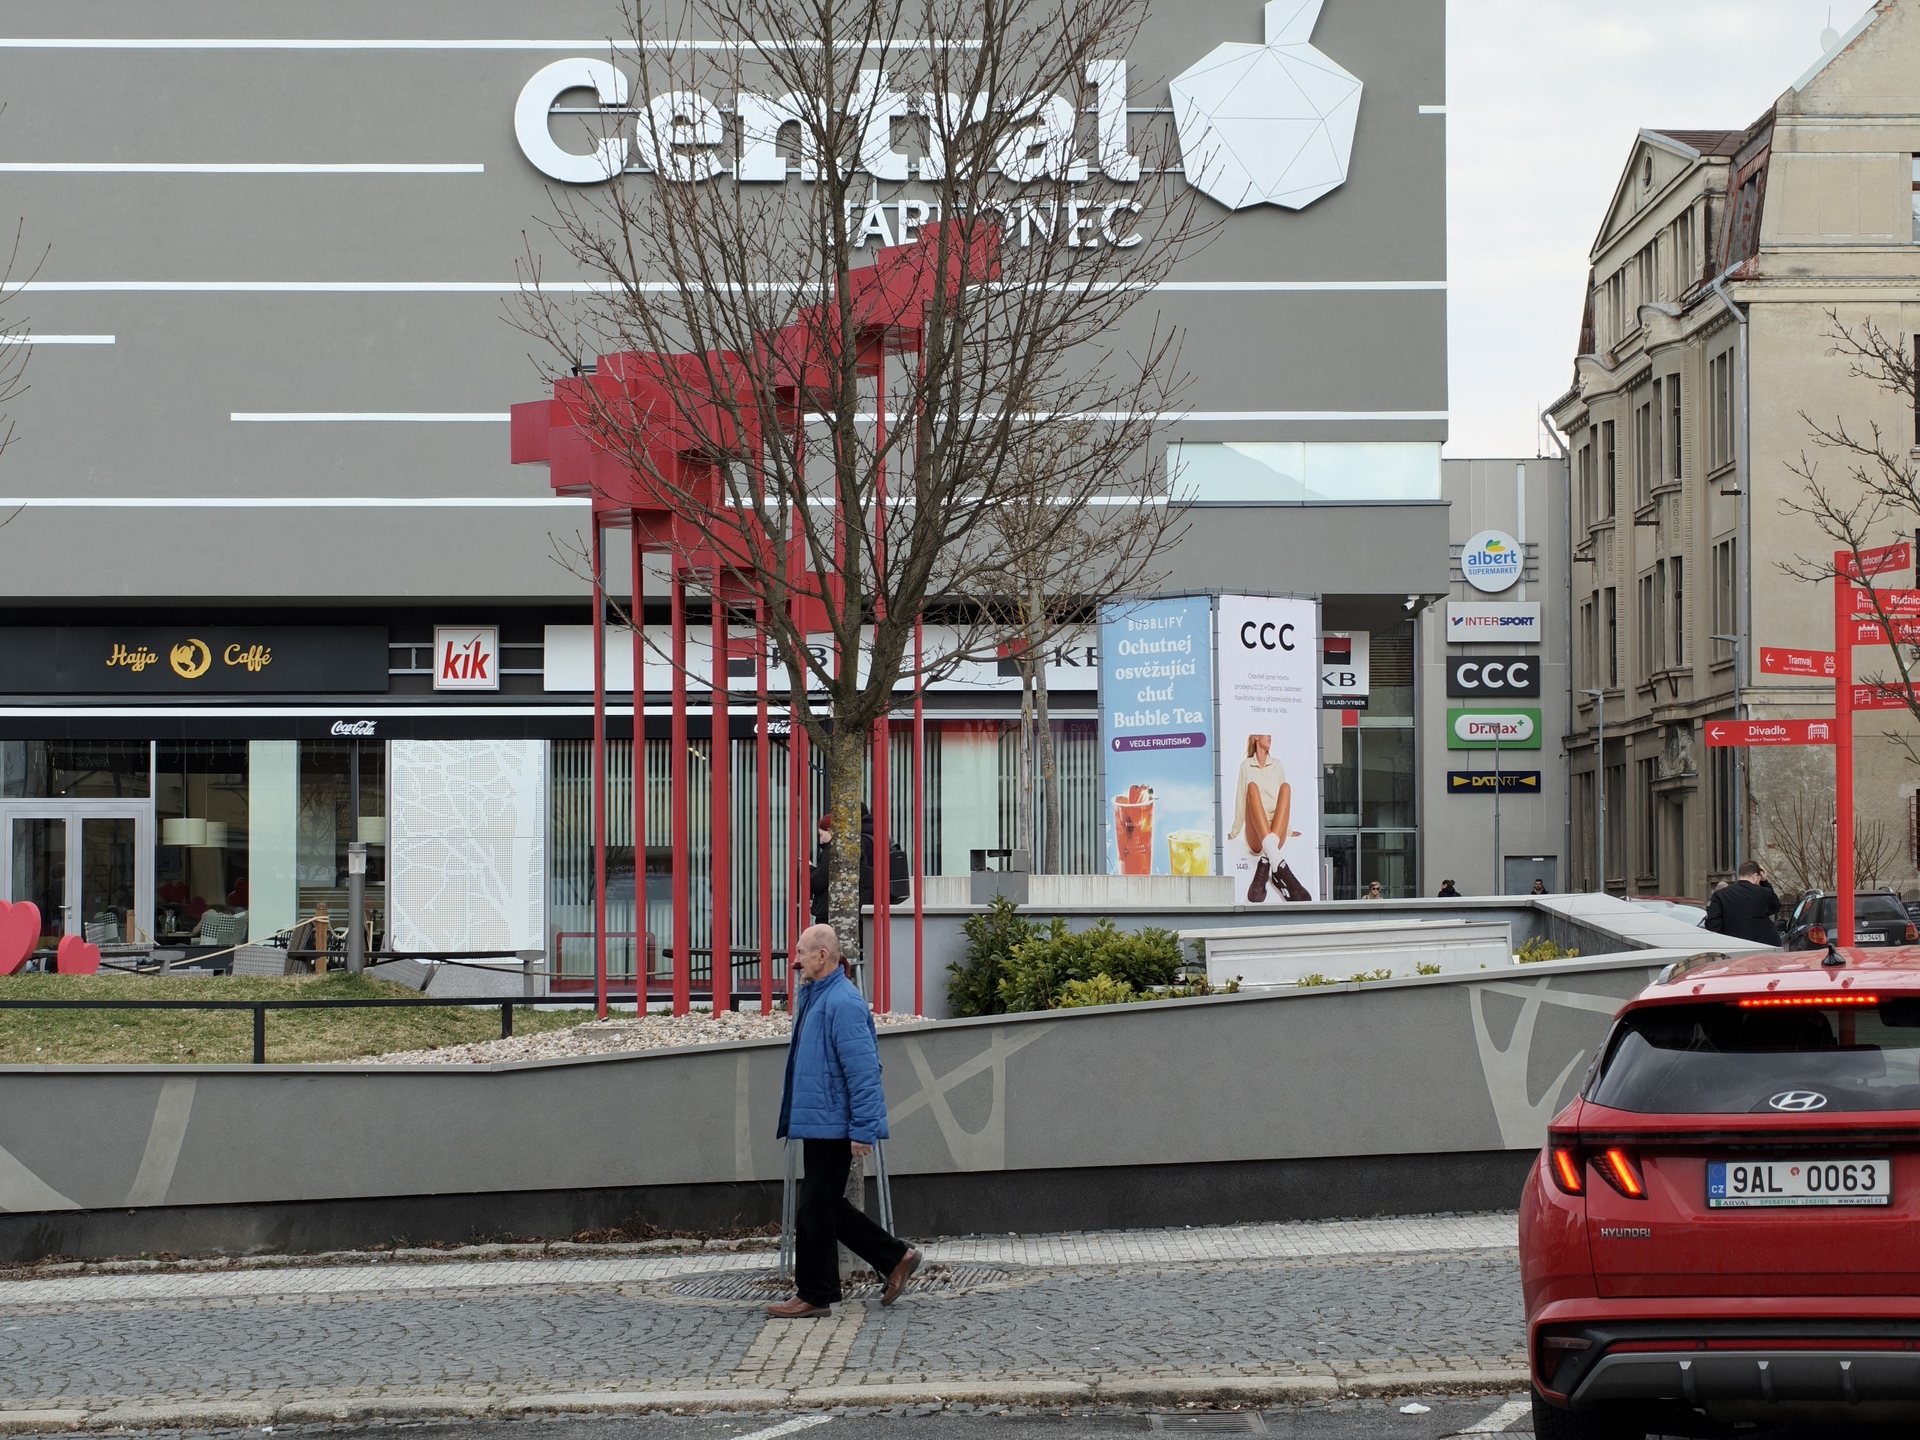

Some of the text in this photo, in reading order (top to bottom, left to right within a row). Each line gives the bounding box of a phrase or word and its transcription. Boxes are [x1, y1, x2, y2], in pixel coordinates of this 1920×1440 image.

[514, 57, 1140, 184] Central
[1468, 550, 1517, 565] albert
[1468, 567, 1517, 576] SUPERMARKET
[1128, 616, 1184, 632] BUBBLIFY
[1466, 617, 1534, 626] INTERSPORT
[1241, 621, 1295, 651] CCC
[1118, 634, 1192, 655] Ochutnej
[106, 644, 273, 672] Hajja Caffé
[1788, 655, 1812, 668] Tramvaj
[1115, 658, 1197, 680] osvěžující
[1457, 663, 1530, 688] CCC
[1137, 683, 1174, 703] chuť
[1114, 708, 1204, 728] Bubble Tea
[331, 720, 377, 735] Coca-Cola
[1470, 723, 1518, 734] Dr.Max
[1749, 726, 1787, 736] Divadlo
[1130, 738, 1191, 748] VEDLE FRUITISIMO
[1734, 1165, 1876, 1193] 9AL 0063
[1712, 1185, 1724, 1193] CZ
[1601, 1228, 1651, 1238] HYUNDAI
